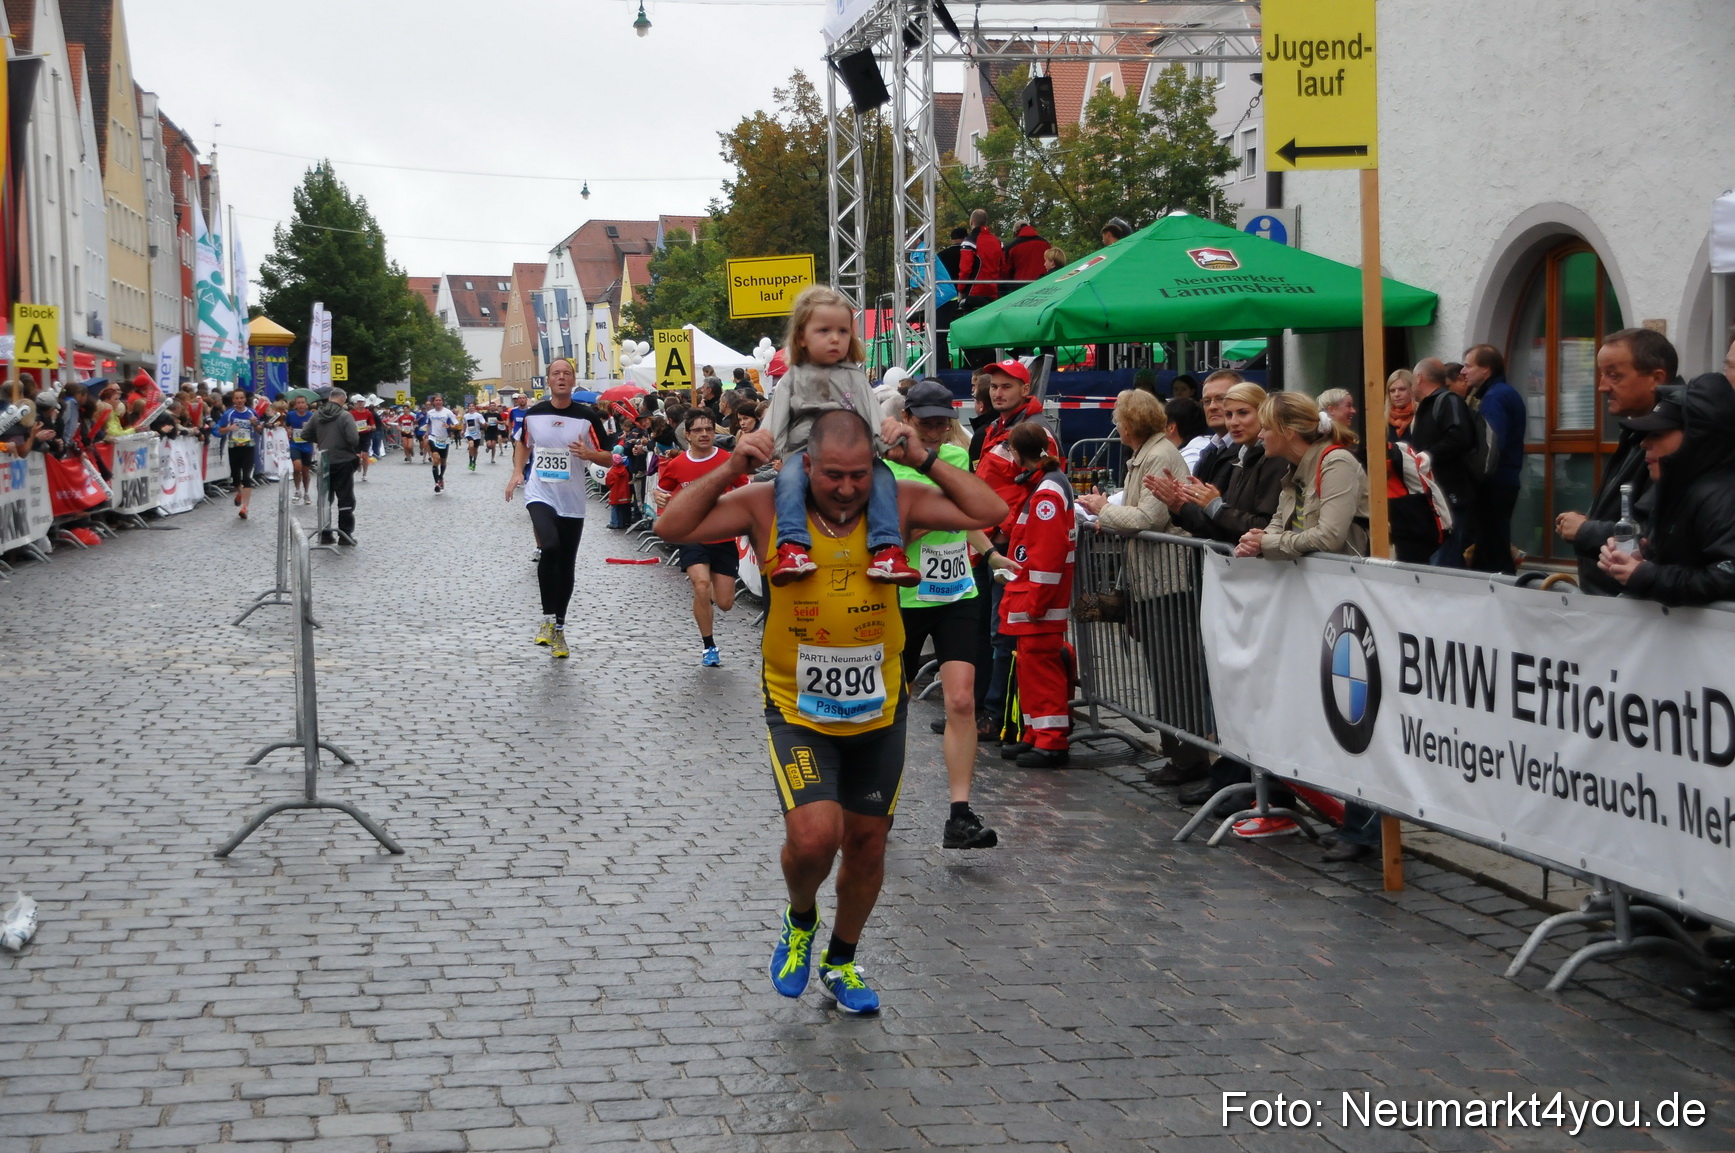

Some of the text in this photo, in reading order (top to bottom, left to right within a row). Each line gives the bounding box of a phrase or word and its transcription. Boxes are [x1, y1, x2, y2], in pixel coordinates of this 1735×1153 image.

[1266, 32, 1372, 68] Jugend-
[1297, 68, 1345, 97] lauf
[734, 274, 808, 288] Schnupper-
[1173, 274, 1287, 286] Neumarkter
[760, 289, 784, 302] lauf
[1158, 283, 1316, 299] Lammsbräu
[20, 306, 55, 319] Block
[23, 323, 49, 354] A
[658, 331, 690, 343] Block
[664, 347, 687, 376] A
[335, 363, 344, 375] B
[532, 377, 543, 388] KL
[398, 394, 404, 402] C
[536, 456, 567, 470] 2335
[921, 547, 943, 556] PARTL
[926, 554, 966, 580] 2906
[929, 583, 964, 593] Rosalinde
[794, 606, 819, 616] Seidl
[1324, 606, 1375, 658] BMW
[799, 652, 872, 663] PARTL Neumarkt
[806, 665, 875, 697] 2890
[1398, 631, 1735, 768] BMW EfficientD
[796, 750, 817, 778] Run!
[1400, 713, 1504, 783] Weniger
[1508, 740, 1667, 827] Verbrauch.
